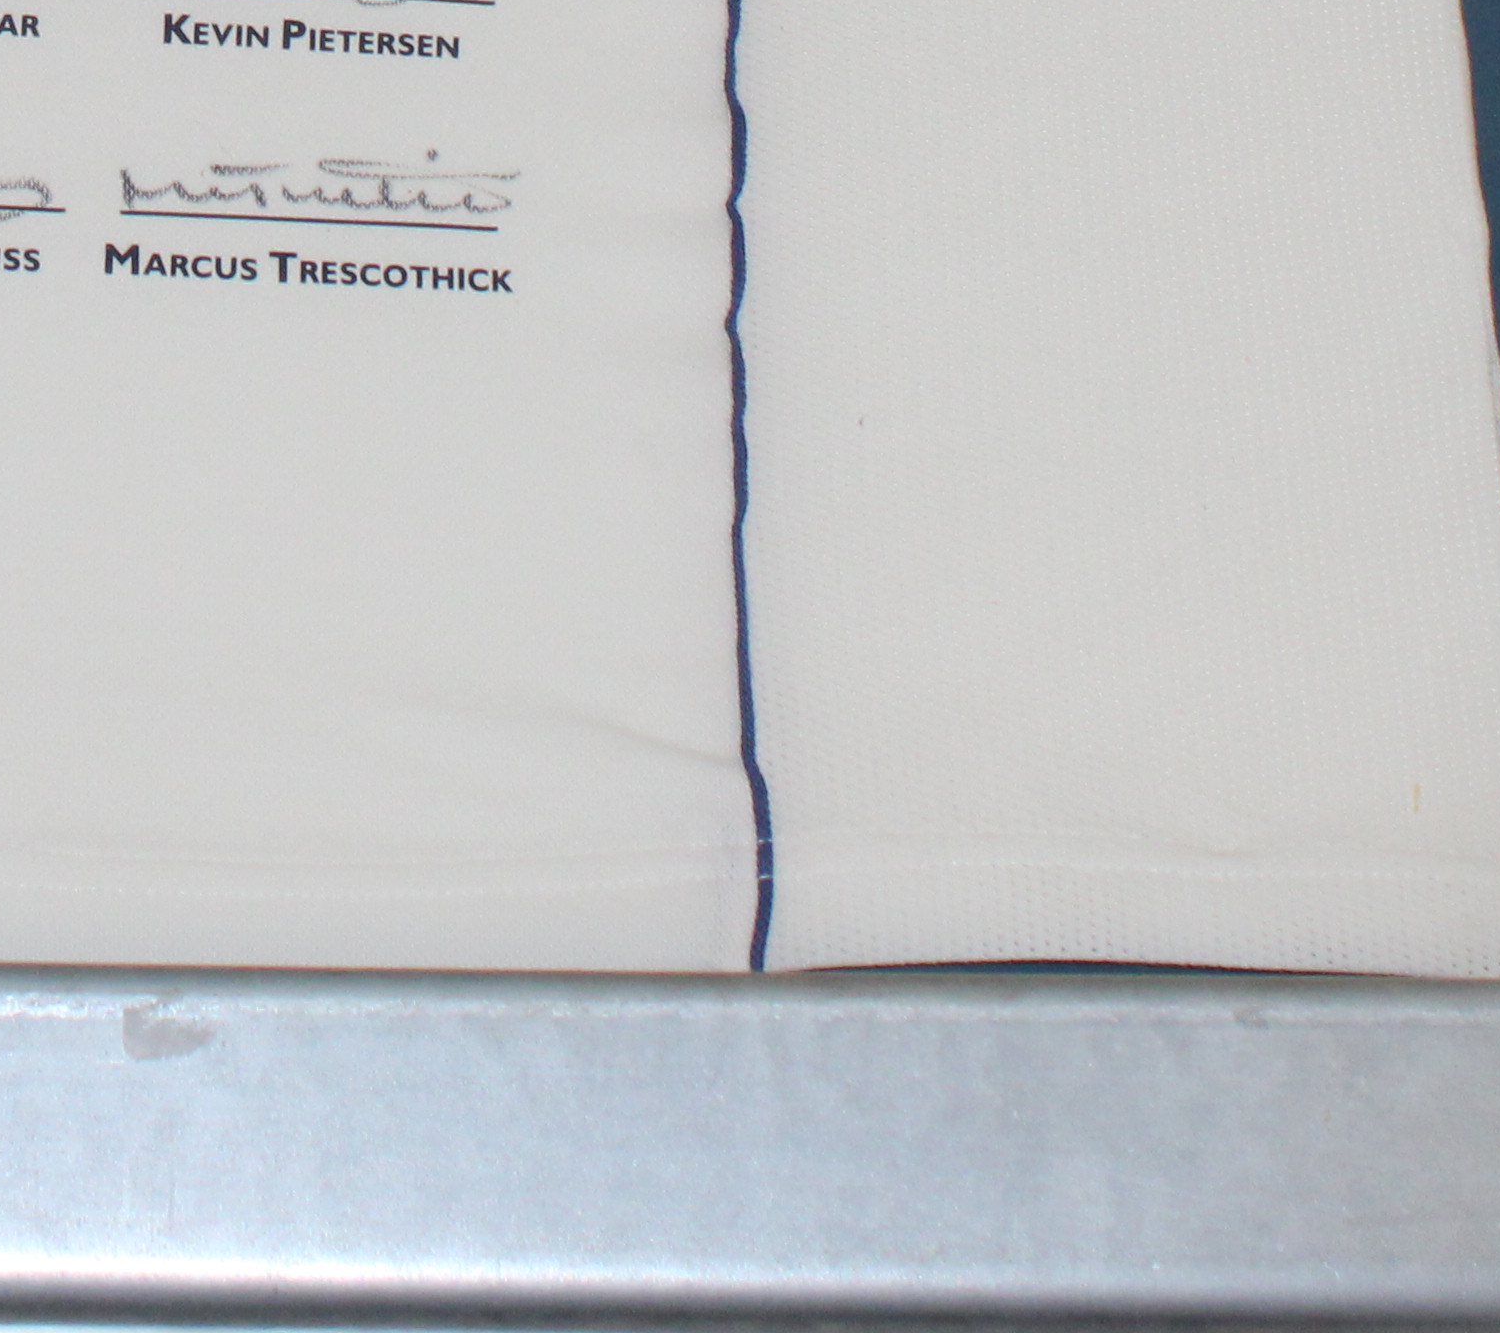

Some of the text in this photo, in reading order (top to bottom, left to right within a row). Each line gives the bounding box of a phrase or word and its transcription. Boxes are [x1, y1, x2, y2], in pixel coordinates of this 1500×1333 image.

[163, 14, 459, 58] KEVIN PIETERSEN
[104, 244, 511, 292] MARCUS TRESCOTHICK
